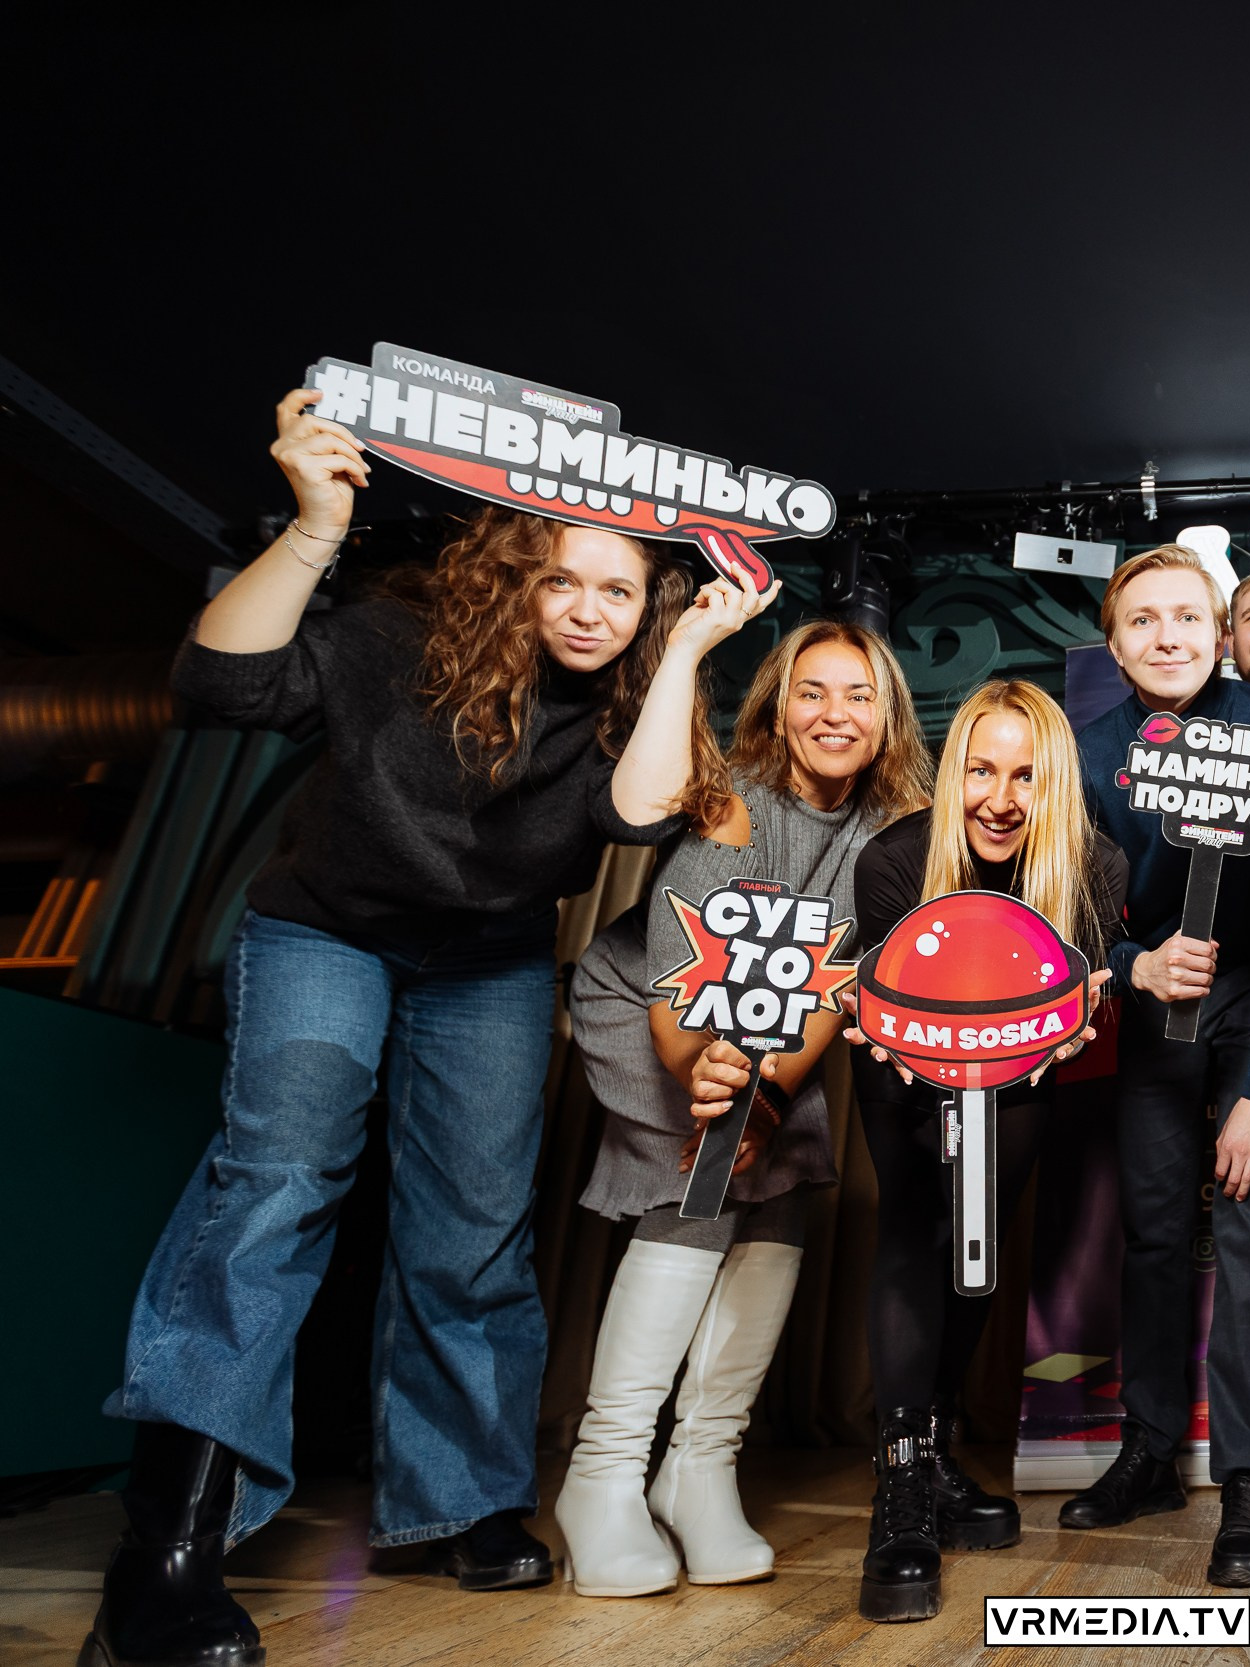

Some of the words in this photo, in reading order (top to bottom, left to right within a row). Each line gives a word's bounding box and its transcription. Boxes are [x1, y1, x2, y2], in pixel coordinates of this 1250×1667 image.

[392, 354, 496, 395] КОМАНДА
[314, 363, 834, 533] #НЕВМИНЬКО
[1180, 825, 1244, 843] ЭЙНШТЕЙН
[738, 881, 782, 893] ГЛАВНЫЙ
[705, 891, 830, 943] СУЕ
[727, 938, 811, 989] ТО
[683, 984, 817, 1035] ЛОГ
[880, 1012, 897, 1038] I
[903, 1021, 951, 1049] AM
[958, 1011, 1064, 1050] SOSKA
